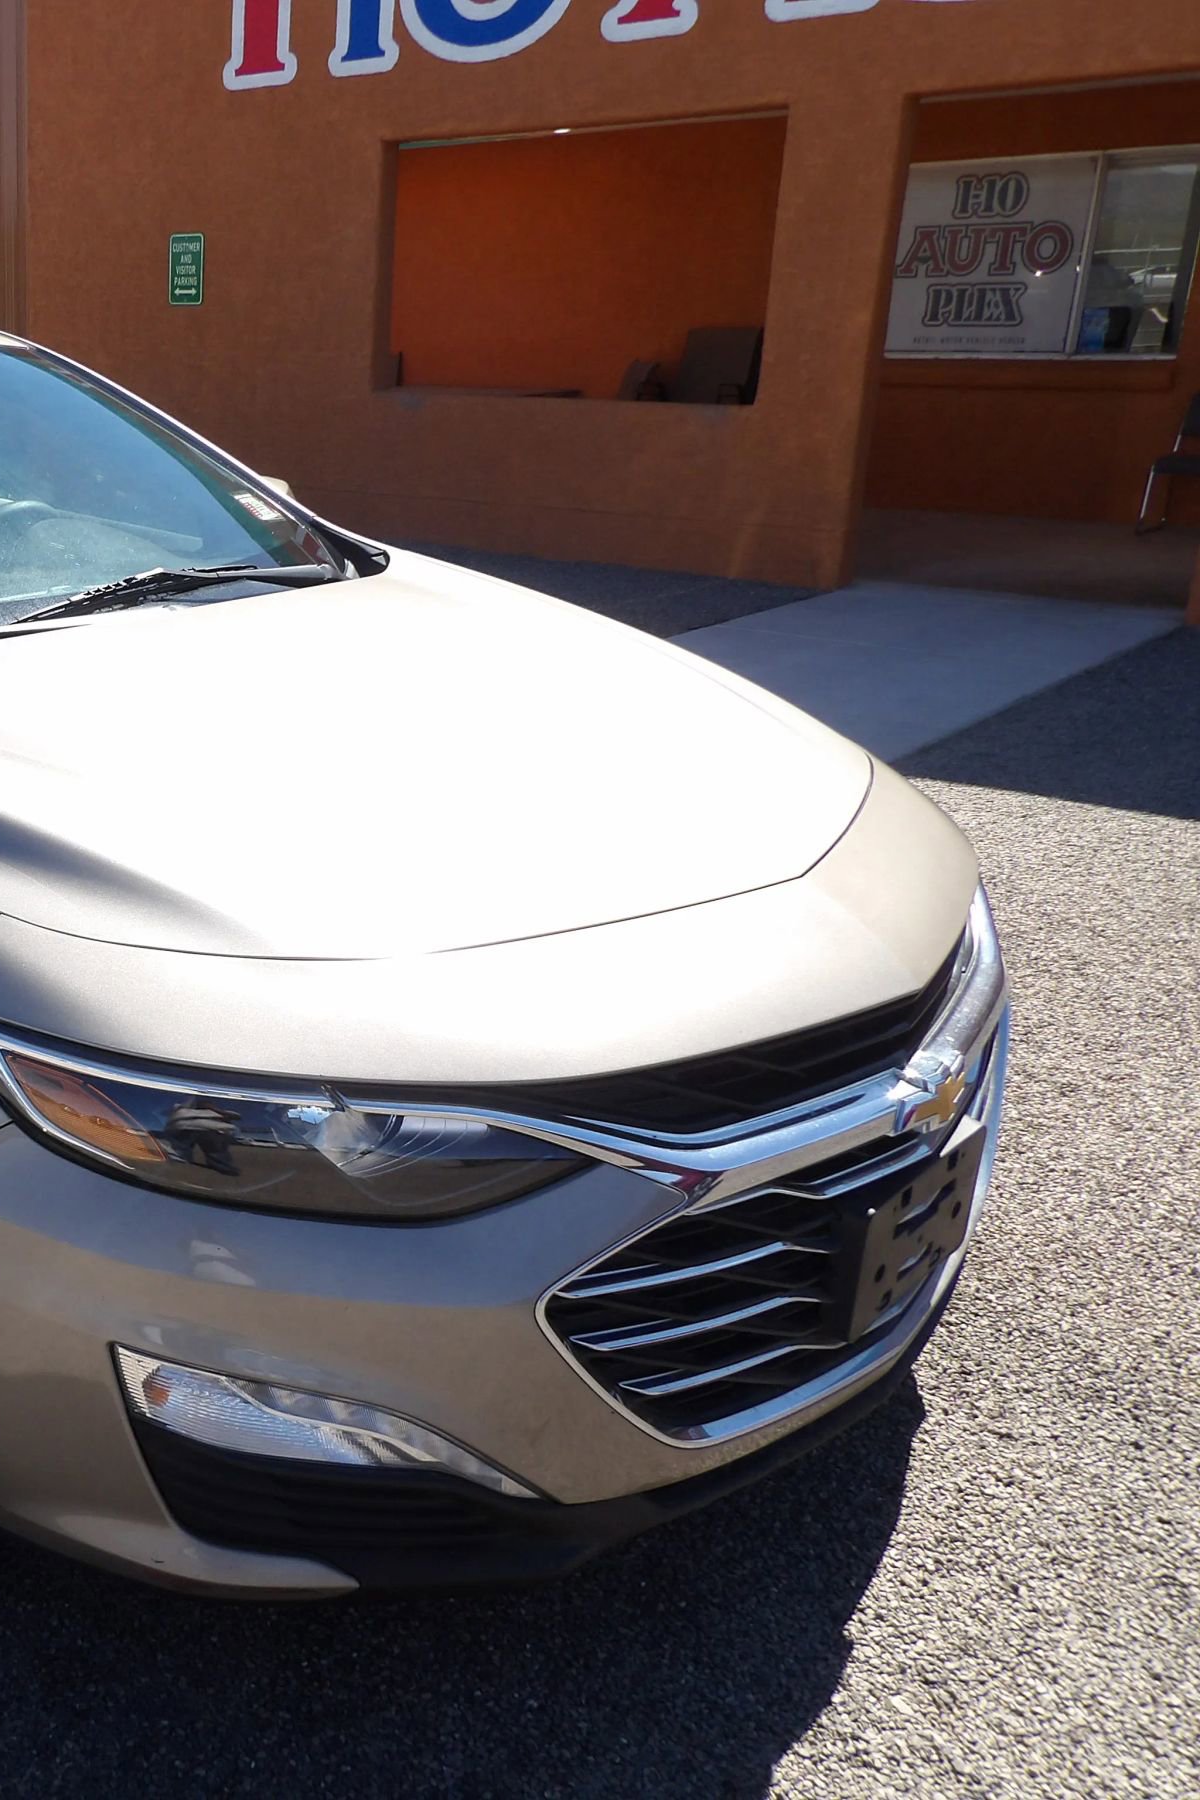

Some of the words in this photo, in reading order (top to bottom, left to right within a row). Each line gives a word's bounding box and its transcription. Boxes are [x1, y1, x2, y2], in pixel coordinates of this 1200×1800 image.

[172, 242, 200, 253] CUSTOMER
[895, 220, 1074, 278] AUTO
[180, 254, 193, 264] AND
[175, 265, 196, 275] VISITOR
[174, 276, 198, 286] PARKING
[922, 282, 1029, 327] PLEX
